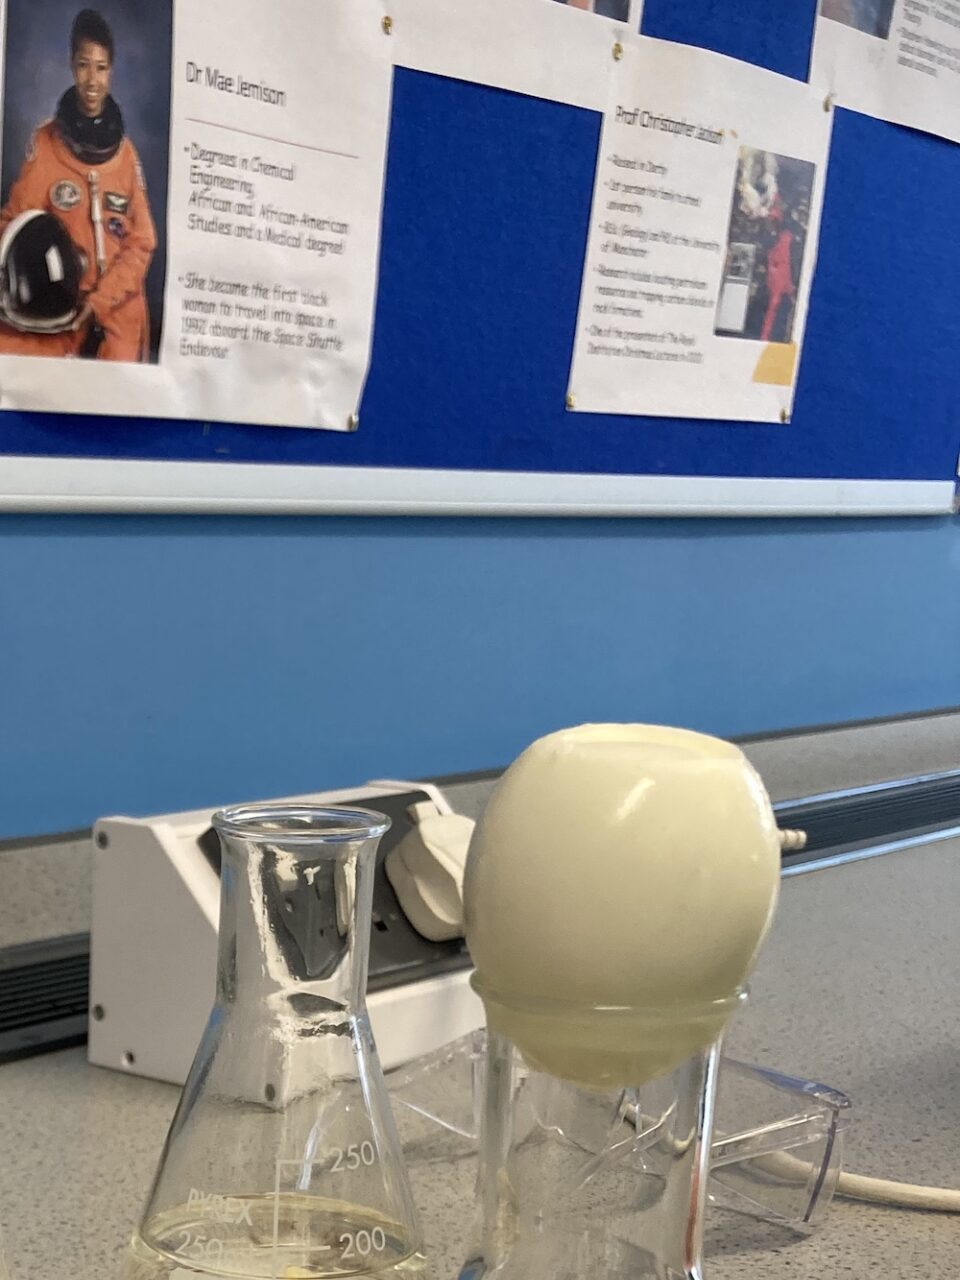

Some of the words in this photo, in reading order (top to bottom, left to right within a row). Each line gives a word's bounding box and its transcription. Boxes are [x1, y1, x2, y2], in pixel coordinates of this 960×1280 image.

[186, 61, 203, 83] Dr
[205, 67, 234, 94] Mae
[236, 76, 287, 107] Jemison
[191, 142, 237, 168] Degrees
[250, 156, 295, 181] Chemical
[188, 187, 232, 212] African
[235, 199, 256, 217] and
[187, 213, 232, 236] Studies
[235, 222, 254, 240] and
[184, 272, 207, 291] She
[251, 282, 269, 300] the
[272, 283, 297, 303] first
[219, 301, 232, 317] to
[270, 308, 291, 324] into
[252, 325, 271, 344] the
[272, 326, 304, 349] Space
[330, 1141, 375, 1173] 250
[186, 1187, 254, 1227] PYREX
[339, 1227, 386, 1259] 200
